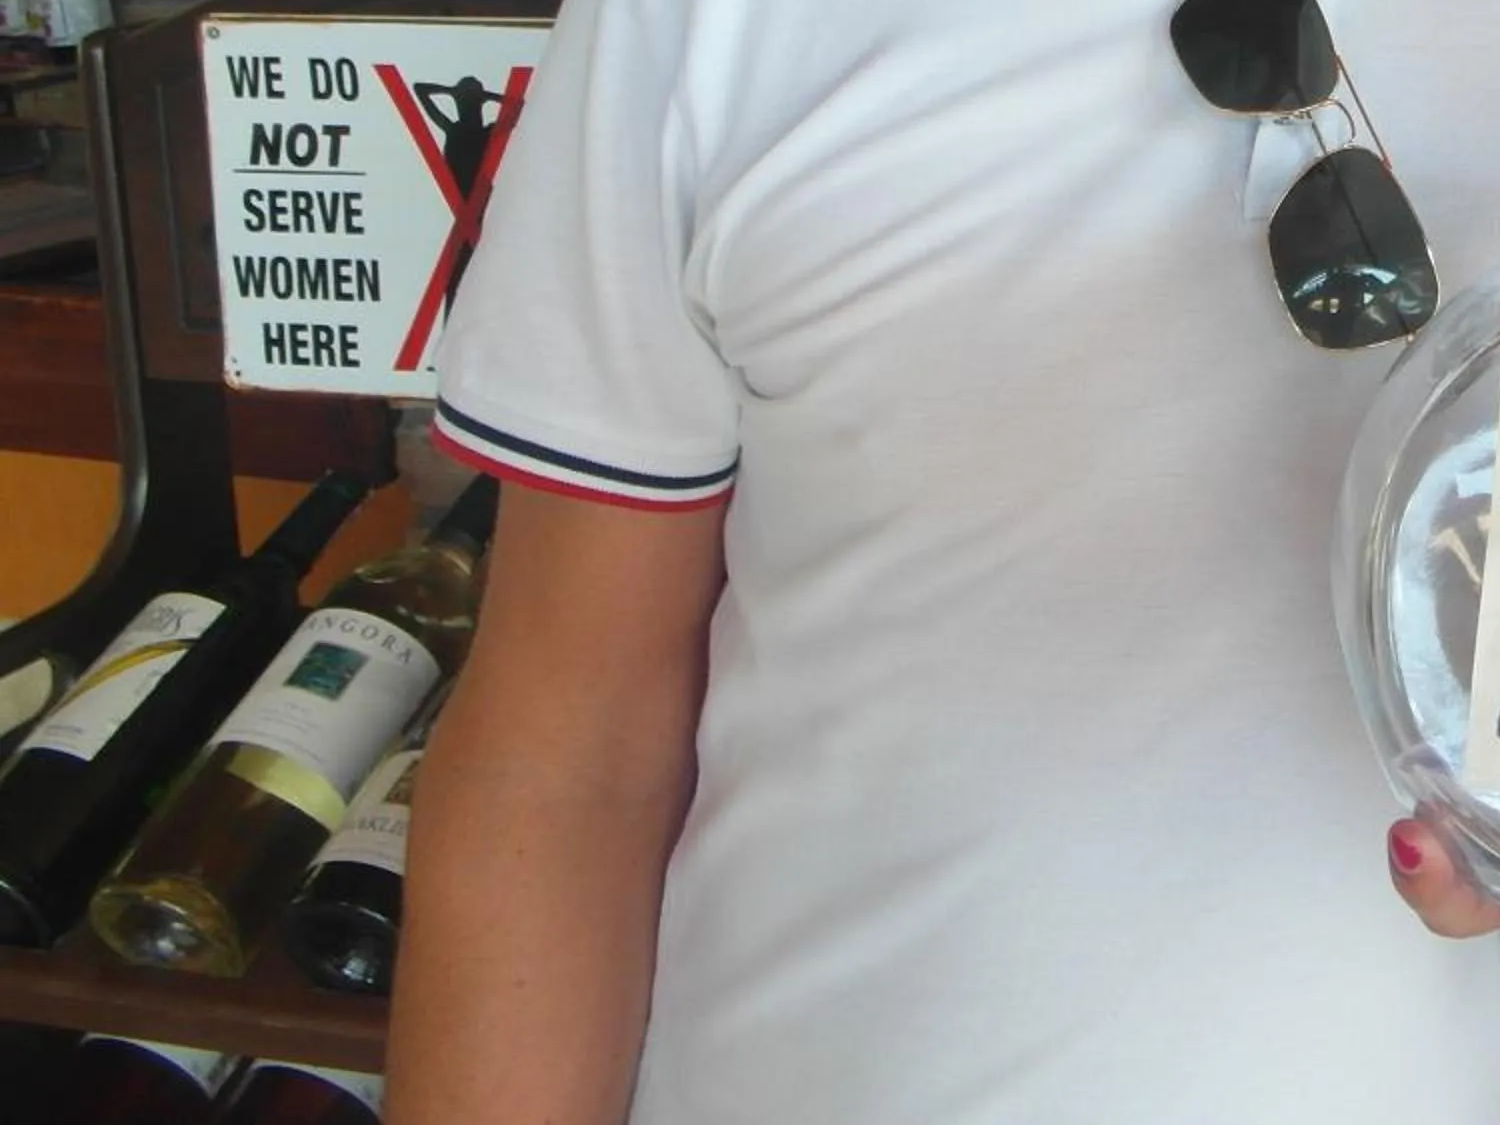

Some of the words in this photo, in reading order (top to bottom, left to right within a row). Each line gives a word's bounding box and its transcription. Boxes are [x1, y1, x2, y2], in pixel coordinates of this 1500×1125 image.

[226, 55, 286, 100] WE
[307, 56, 361, 102] DO
[249, 122, 352, 168] NOT
[242, 188, 365, 235] SERVE
[232, 255, 382, 303] WOMEN
[262, 322, 361, 368] HERE
[303, 614, 413, 665] ANGORA
